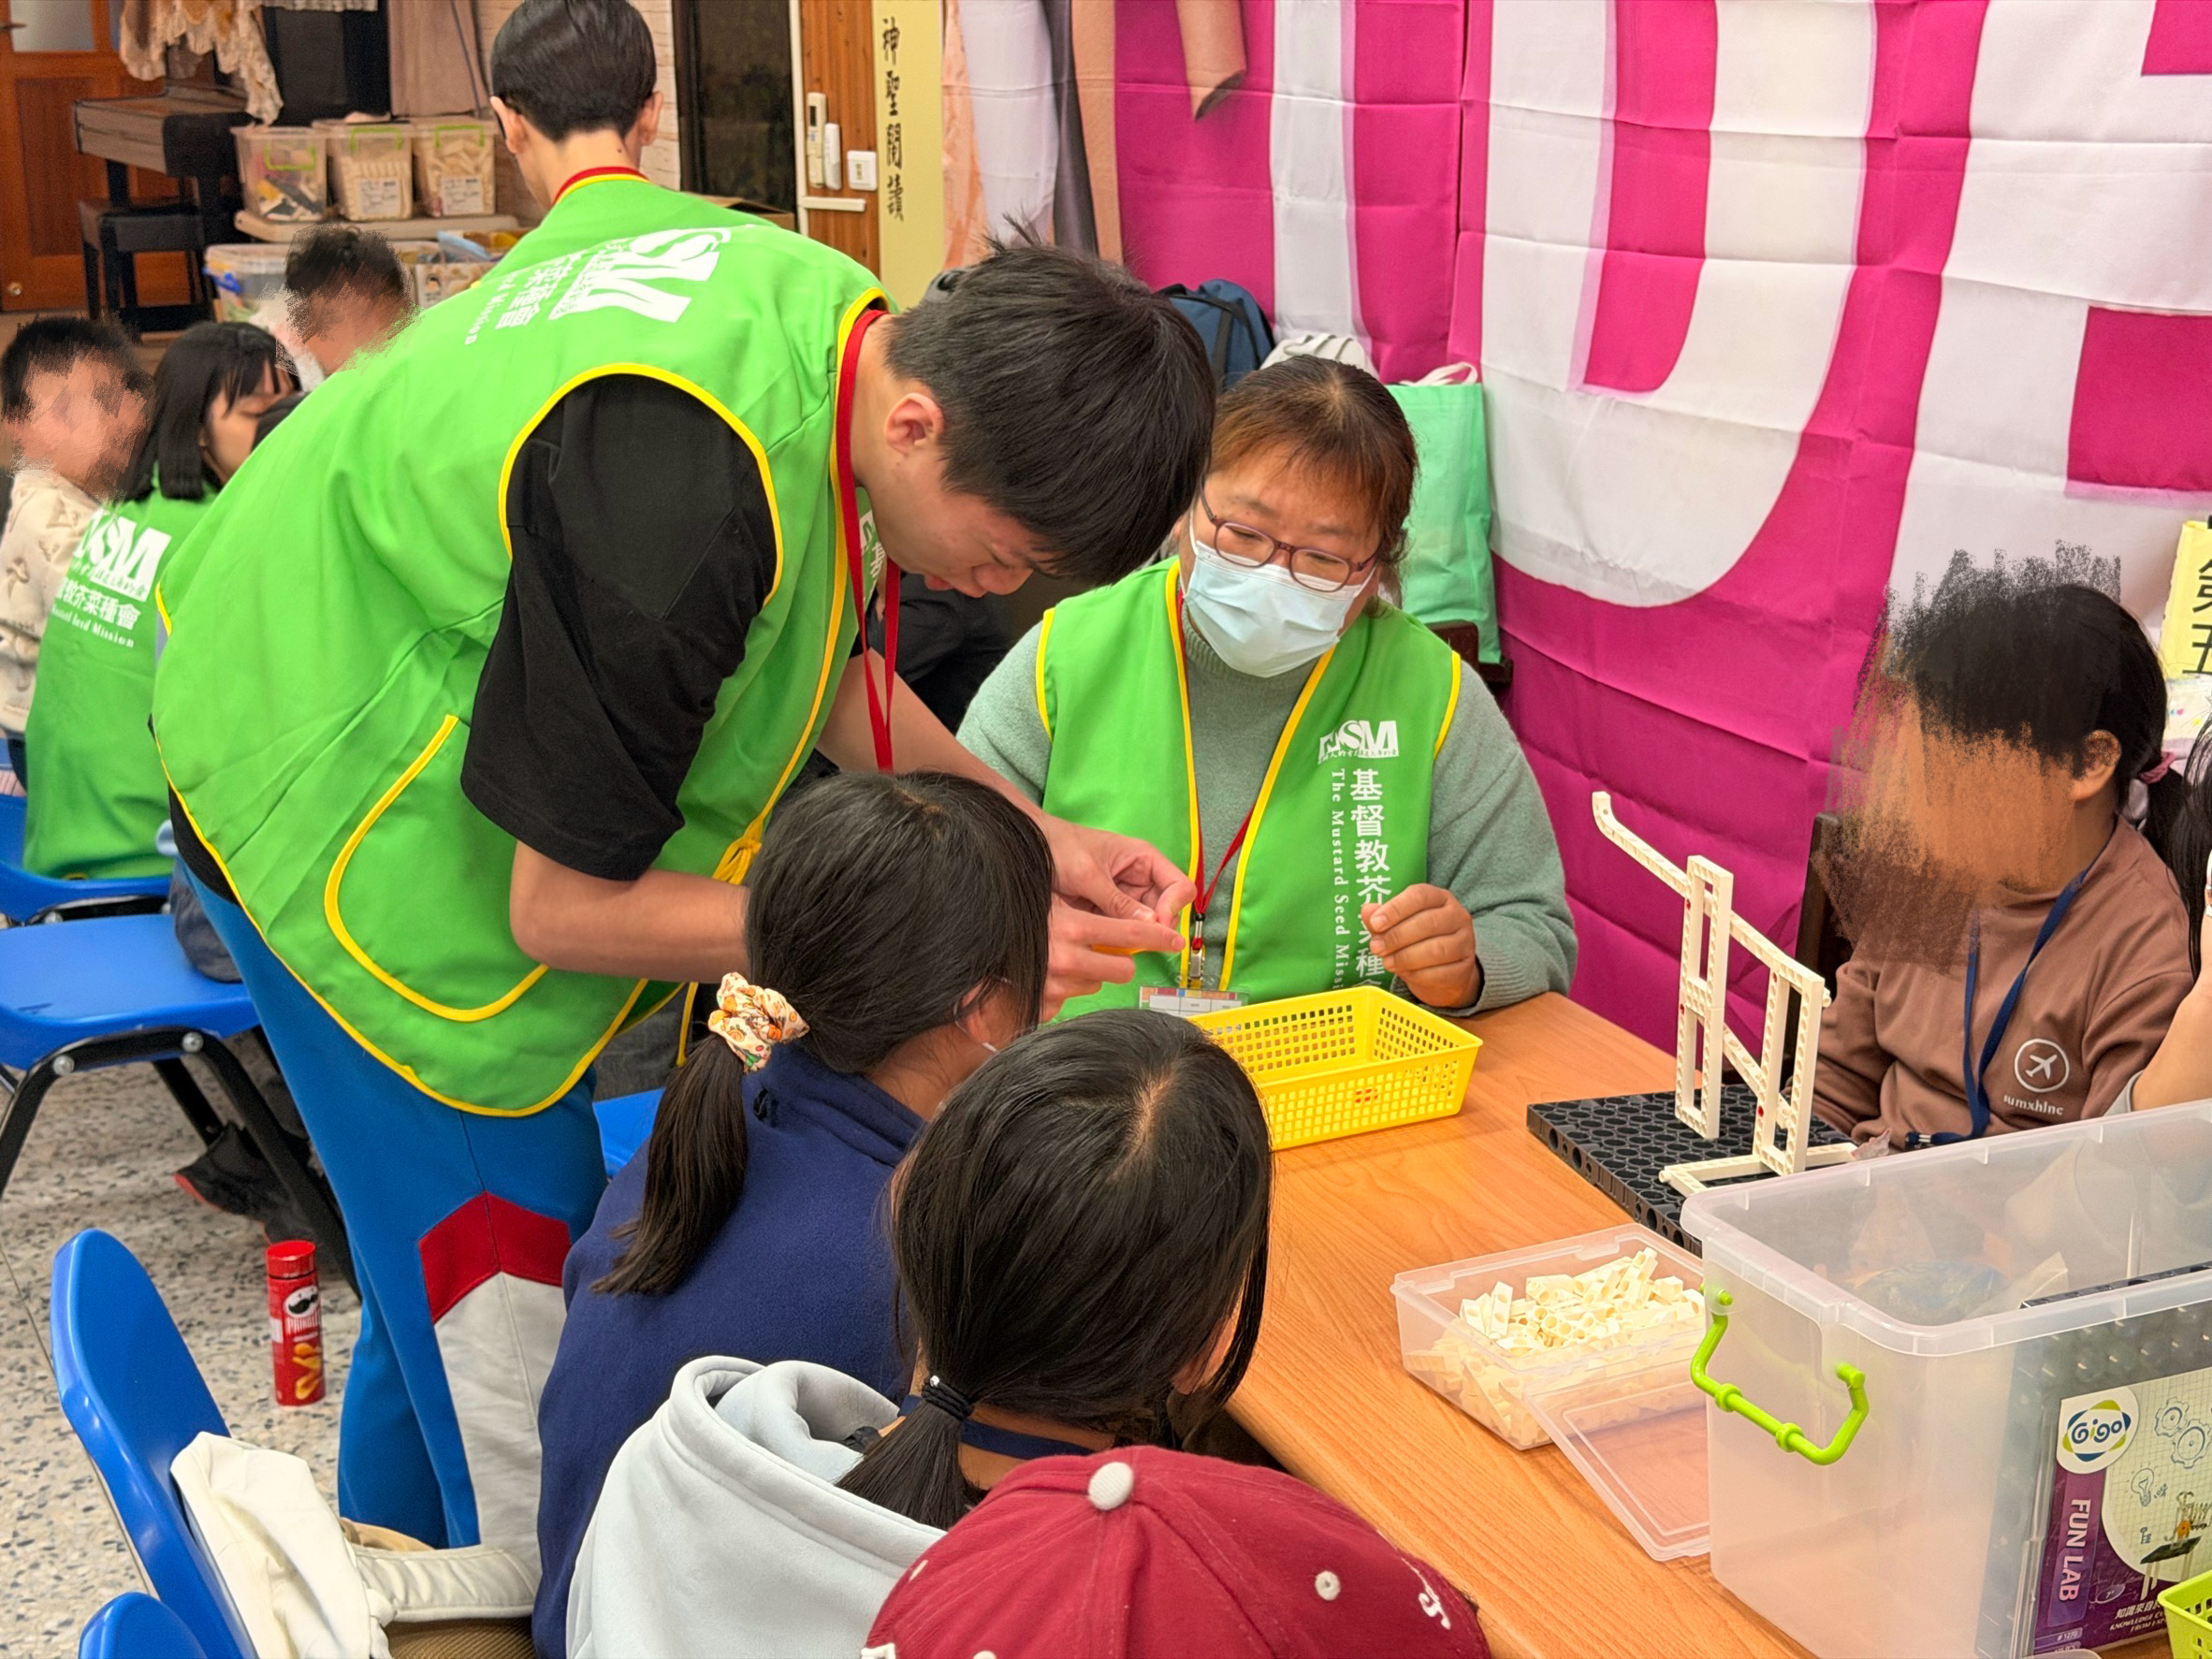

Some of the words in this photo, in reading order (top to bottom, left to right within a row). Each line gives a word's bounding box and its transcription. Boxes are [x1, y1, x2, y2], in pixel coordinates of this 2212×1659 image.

[1332, 768, 1346, 802] The
[1332, 810, 1349, 885] Mustard
[1334, 895, 1350, 936] Seed
[2071, 1419, 2122, 1444] Gigo
[2065, 1499, 2091, 1548] FUN
[2059, 1555, 2084, 1601] LAB
